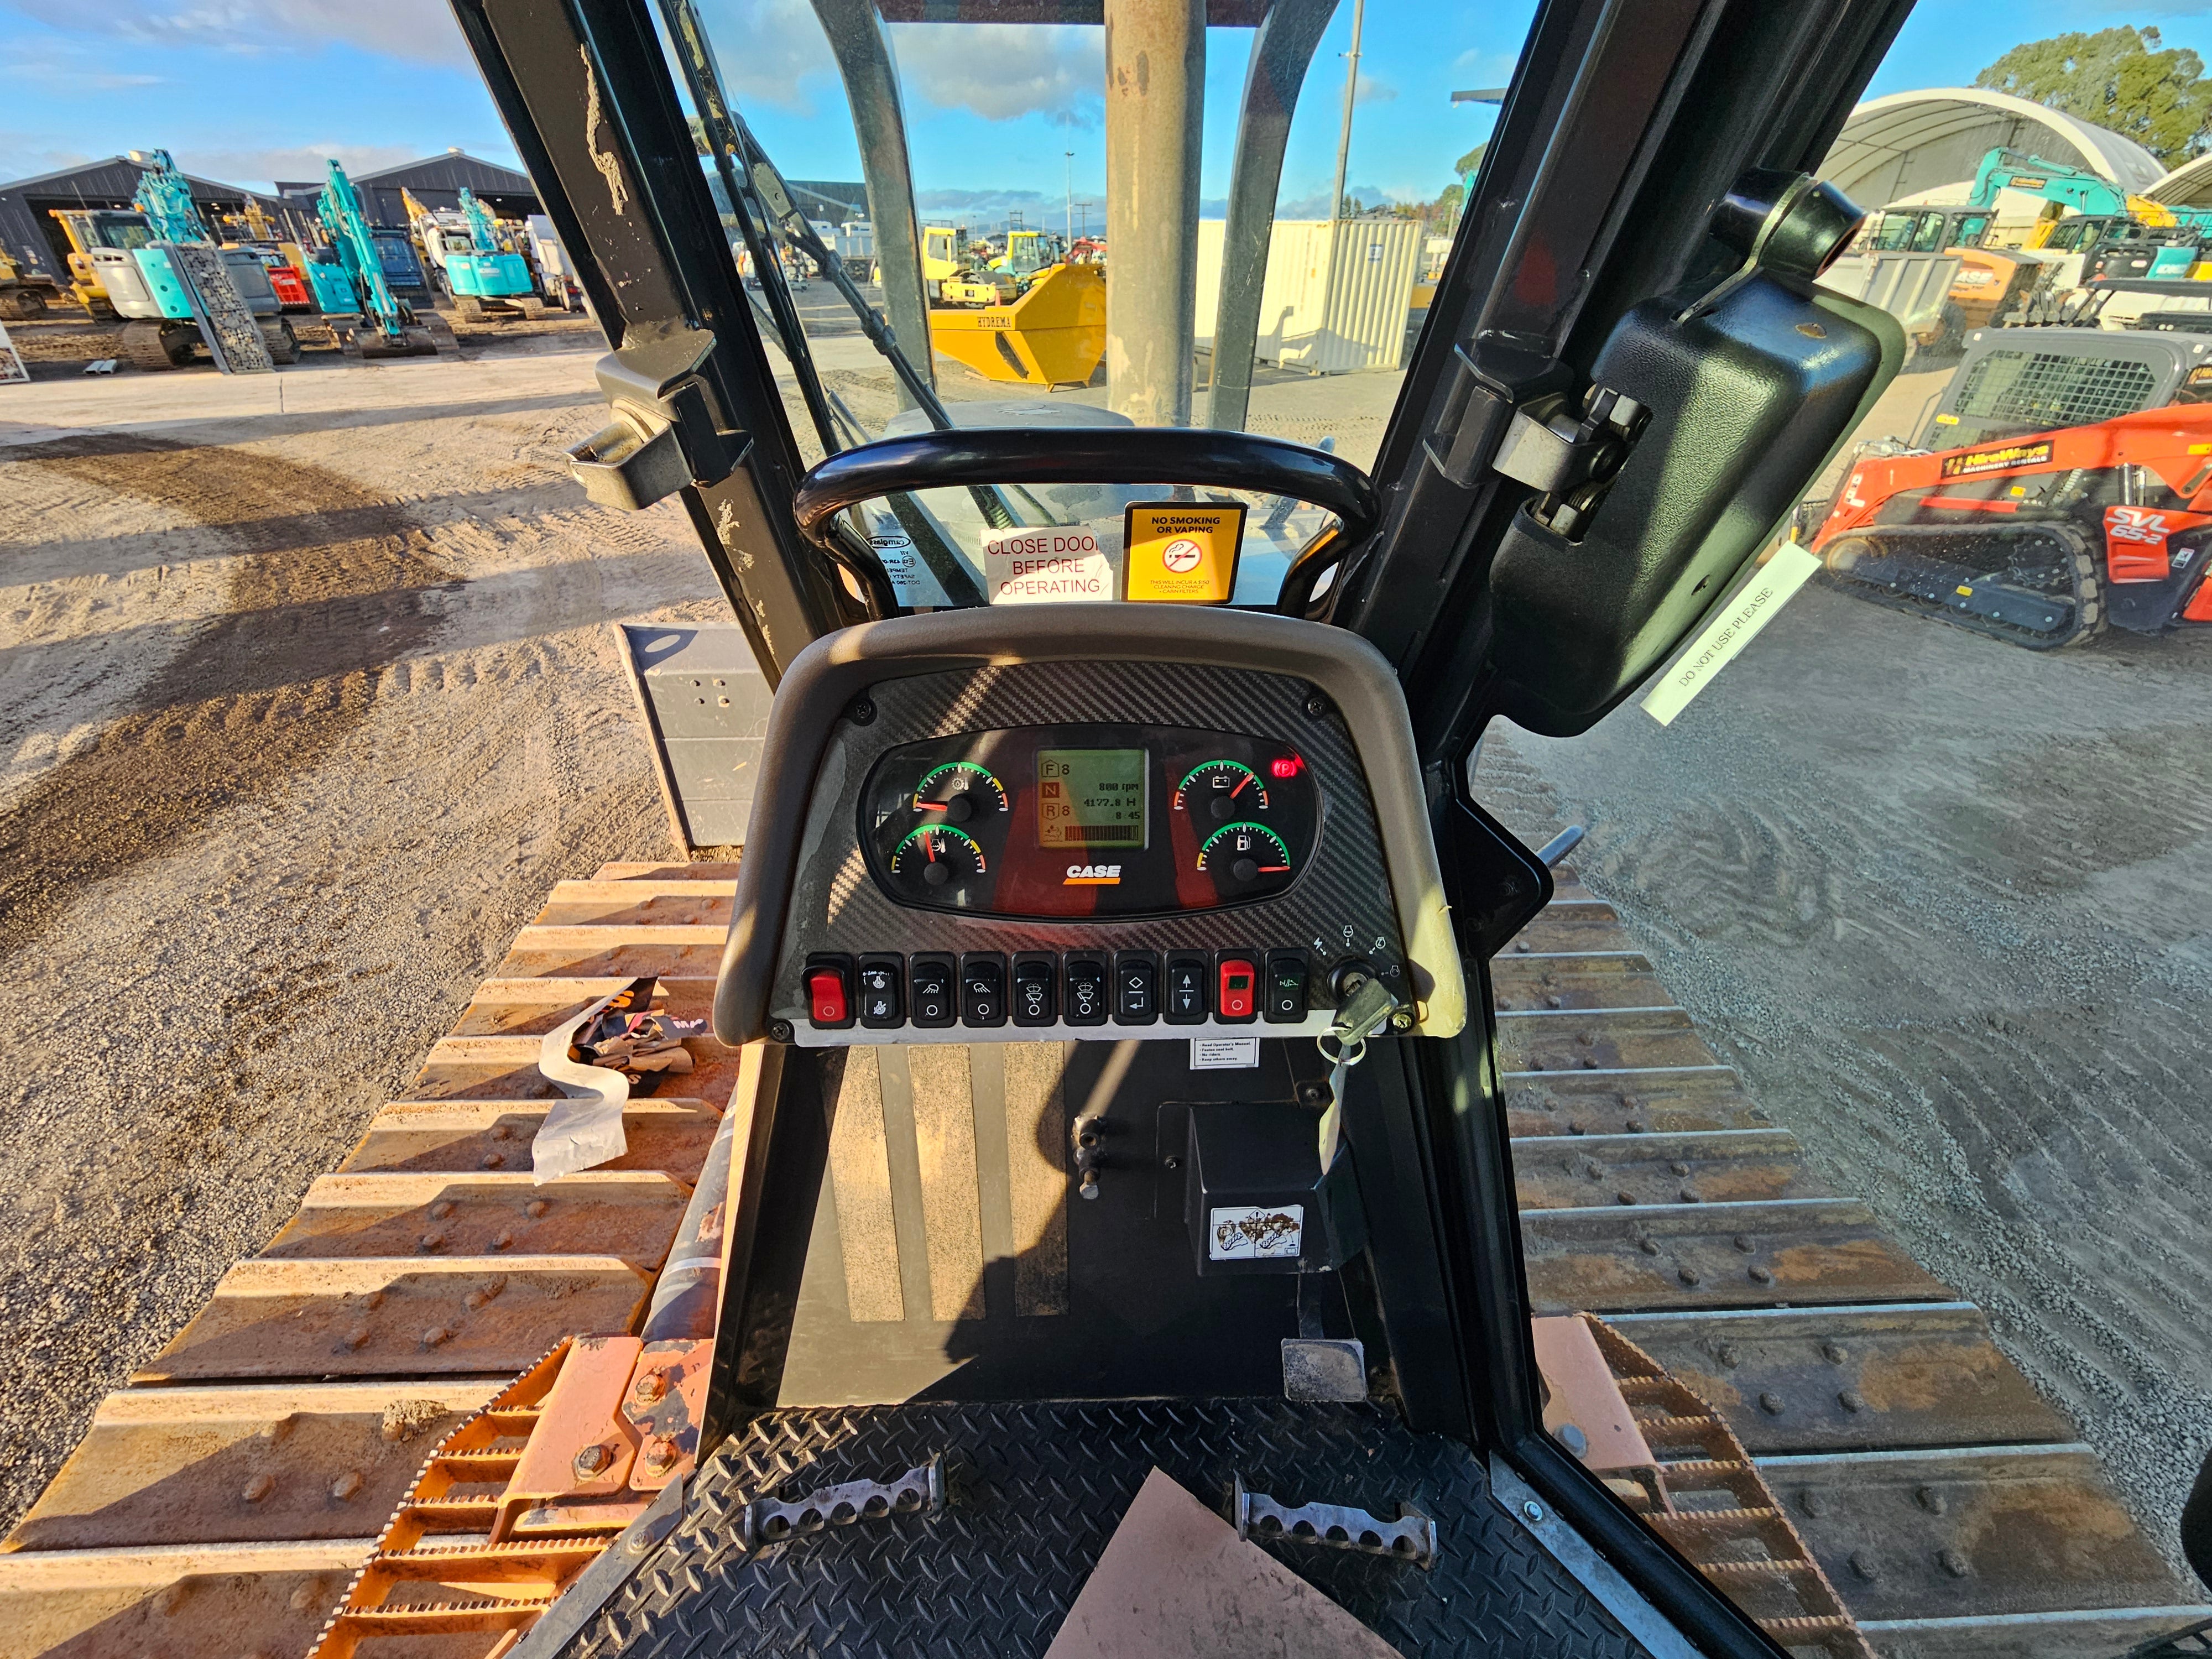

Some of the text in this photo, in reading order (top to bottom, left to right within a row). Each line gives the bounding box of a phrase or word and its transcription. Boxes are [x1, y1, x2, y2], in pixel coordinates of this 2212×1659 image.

[1954, 270, 1994, 285] ASE
[977, 316, 1011, 327] HYDREMA
[1965, 445, 2049, 466] HireWays
[1963, 455, 2048, 473] MACHINERY RENTALS
[2106, 508, 2170, 533] SVL
[2110, 524, 2163, 545] 65-2
[987, 538, 1048, 555] CLOSE
[1013, 558, 1085, 575] BEFORE
[1000, 578, 1100, 596] OPERATING
[1678, 587, 1774, 687] DO NOT USE PLEASE
[1046, 764, 1070, 775] F 8
[1045, 785, 1057, 796] N
[1121, 783, 1139, 792] rpm
[1126, 797, 1136, 806] H
[1046, 805, 1070, 816] R 8
[1066, 865, 1121, 878] CASE
